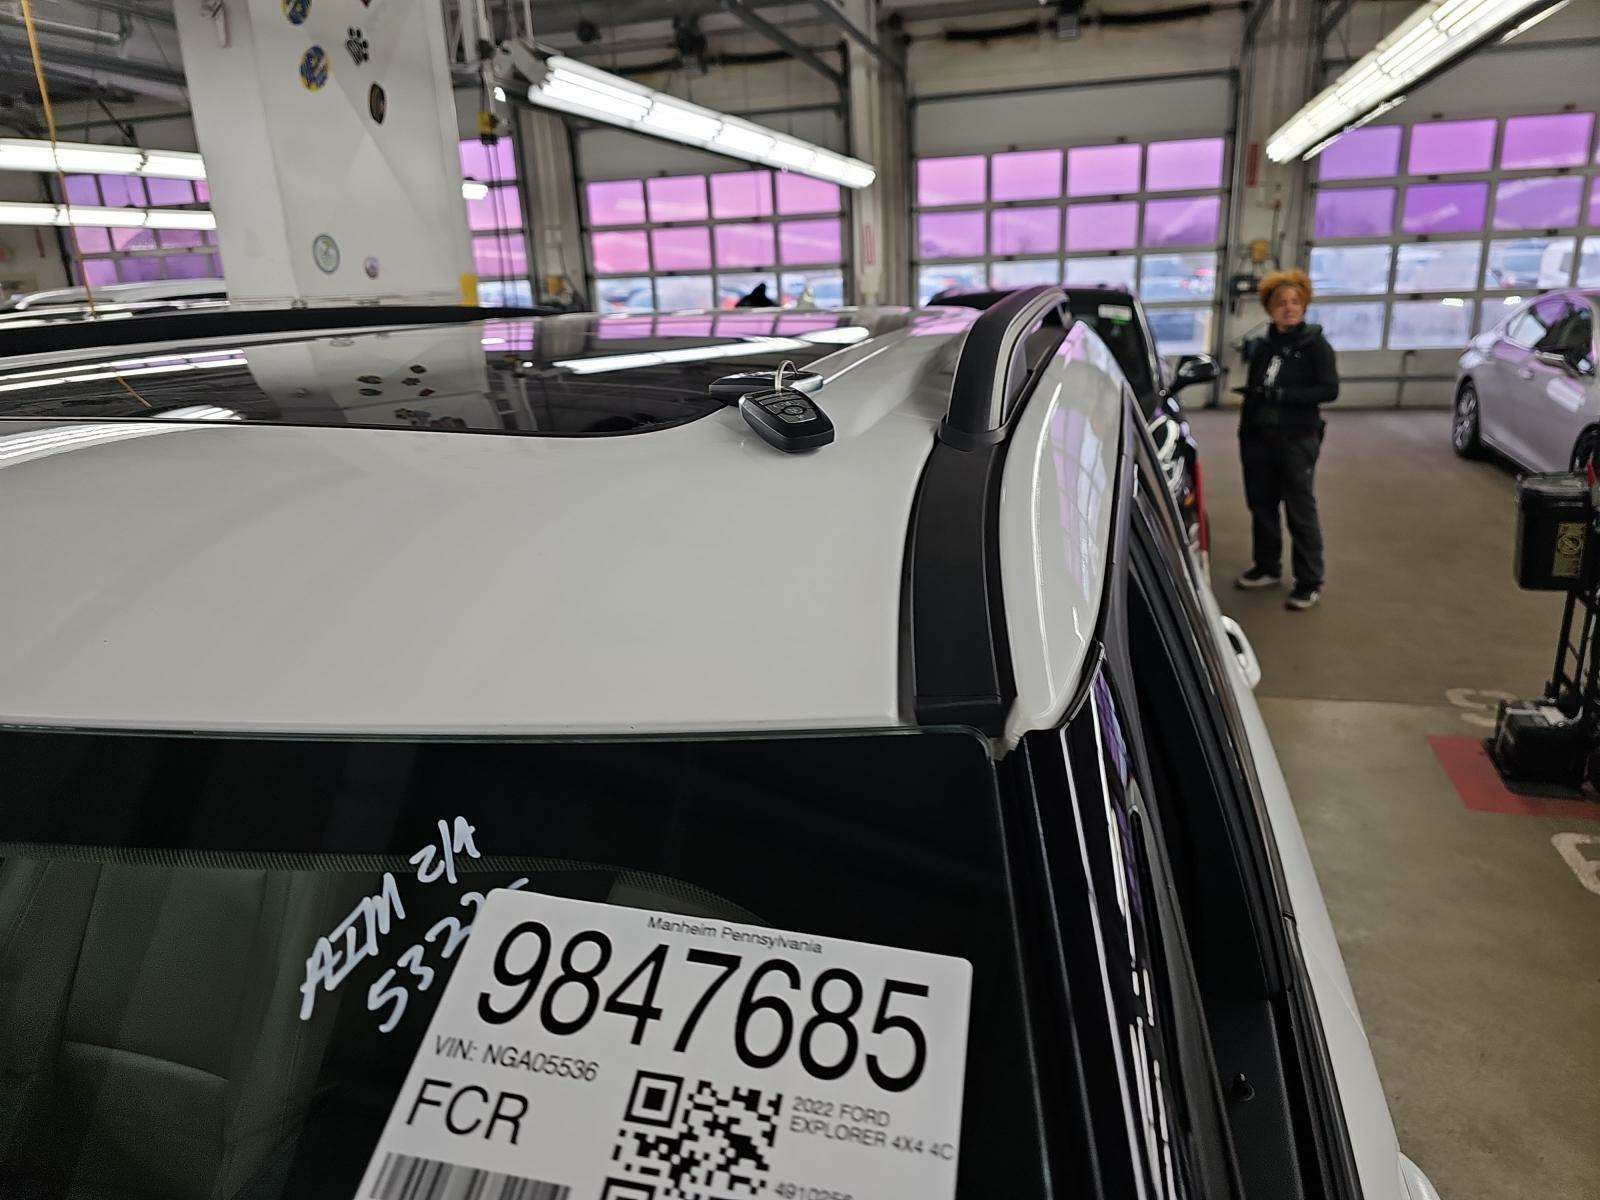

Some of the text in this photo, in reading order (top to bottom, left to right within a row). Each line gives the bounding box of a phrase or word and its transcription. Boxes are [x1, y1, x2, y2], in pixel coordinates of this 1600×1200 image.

[647, 916, 823, 954] Manheim Pennsylvania
[478, 921, 930, 1093] 9847685
[435, 1035, 599, 1082] VIN: NGA05536
[405, 1078, 529, 1145] FCR
[792, 1096, 891, 1127] 2022 FORD
[789, 1115, 955, 1161] EXPLORER 4X4 4C
